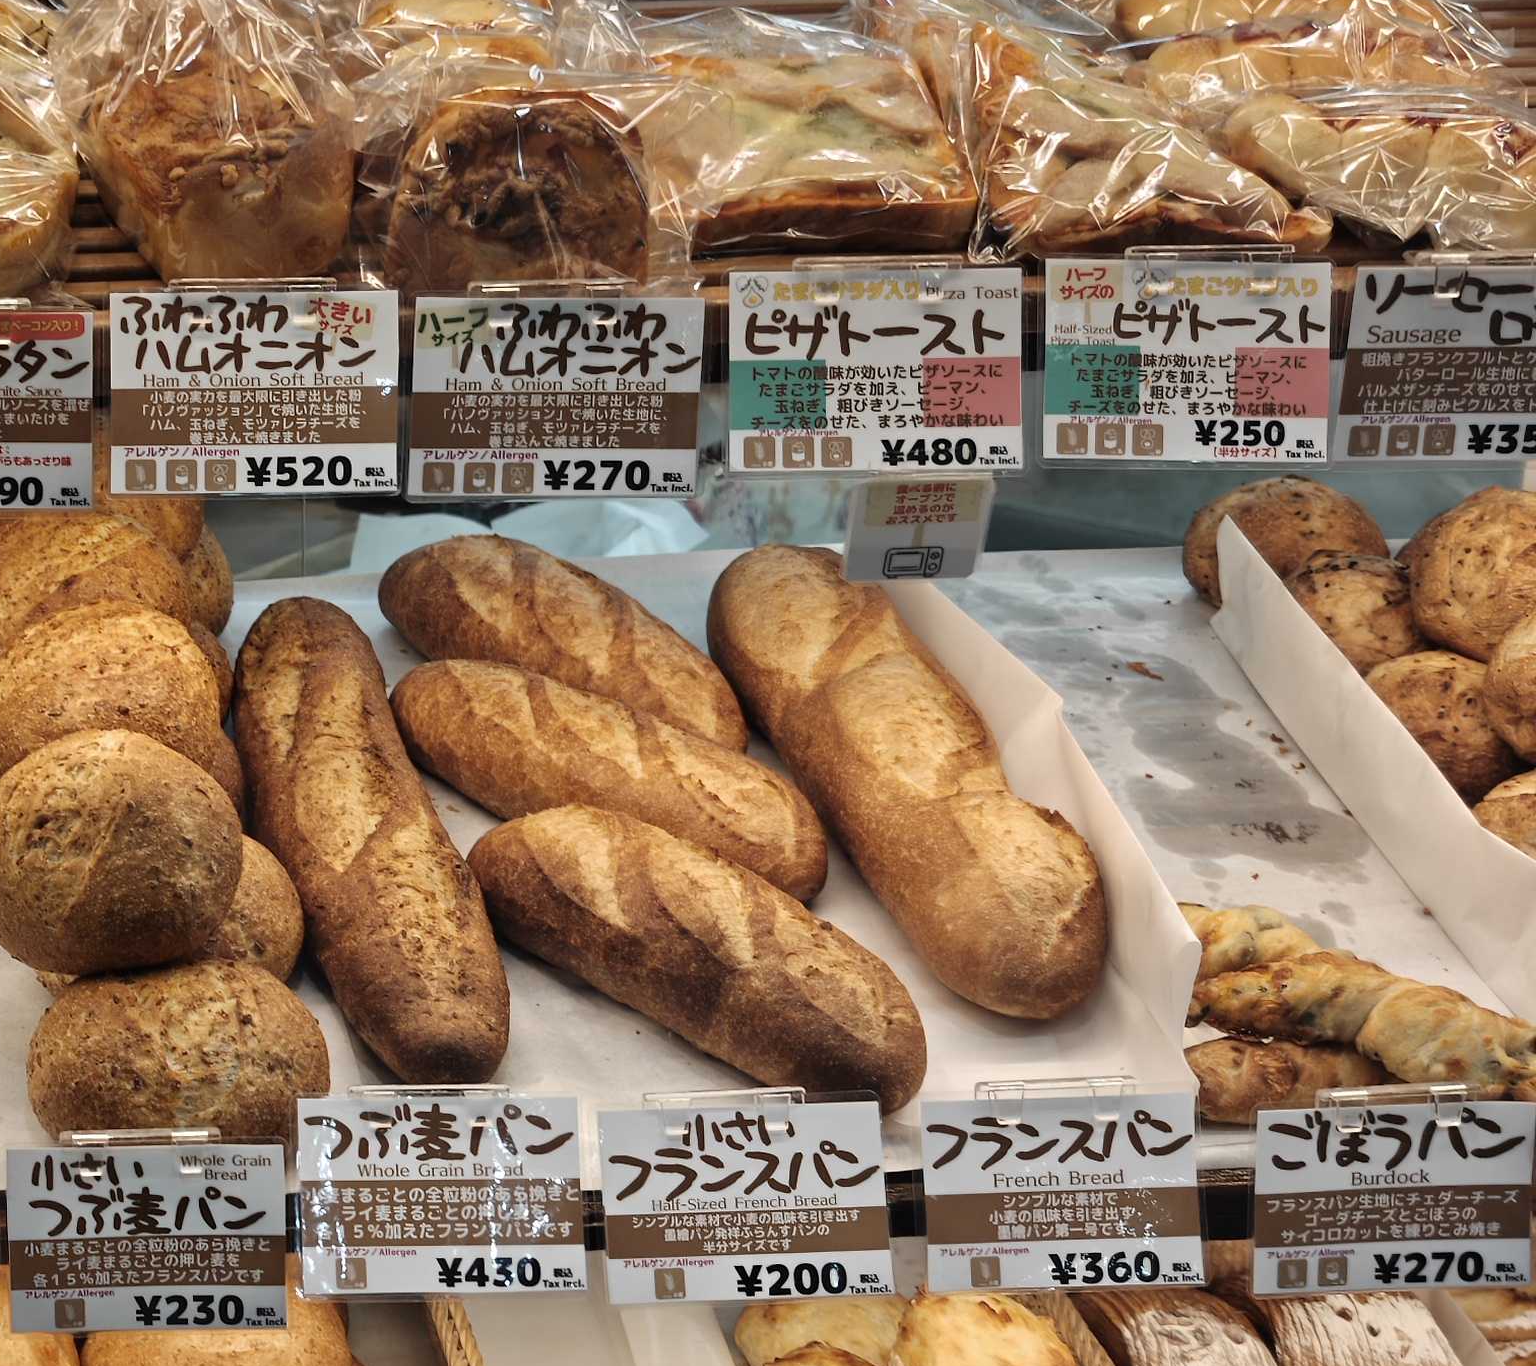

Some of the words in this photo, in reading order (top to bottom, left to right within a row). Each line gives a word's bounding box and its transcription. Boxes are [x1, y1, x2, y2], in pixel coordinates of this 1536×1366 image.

[120, 295, 289, 335] ふわふわ
[309, 297, 372, 325] 大きい
[497, 303, 666, 341] ふわふわ
[1114, 299, 1326, 345] ピザトースト
[746, 305, 1005, 360] ピザトースト
[1366, 325, 1462, 344] Sausage
[135, 331, 376, 373] ハムオニオン
[459, 337, 701, 377] ハムオニオン
[143, 374, 179, 387] Ham
[189, 374, 201, 387] &
[210, 373, 260, 387] Onion
[270, 373, 305, 386] Soft
[314, 372, 364, 386] Bread
[1194, 420, 1286, 447] ¥250
[881, 438, 977, 466] ¥480
[245, 456, 352, 487] ¥520
[543, 460, 650, 491] ¥270
[304, 1103, 574, 1161] つぶ麦パン
[682, 1111, 795, 1151] 小さい
[926, 1109, 1193, 1170] フランスパン
[1269, 1107, 1525, 1171] ごぼうパン
[31, 1153, 144, 1191] 小さい
[181, 1155, 224, 1168] Whole
[232, 1154, 272, 1167] Grain
[204, 1169, 247, 1181] Bread
[608, 1140, 880, 1201] フランスパン
[993, 1173, 1060, 1187] French
[1069, 1170, 1124, 1185] Bread
[1351, 1169, 1430, 1186] Burdock
[29, 1187, 266, 1236] つぶ麦パン
[651, 1197, 727, 1212] Half-Sized
[734, 1196, 787, 1209] French
[794, 1193, 838, 1206] Bread
[1003, 1192, 1119, 1208] シンプルな素材で
[1305, 1207, 1477, 1227] ゴーダチーズとごぼうの
[56, 1253, 240, 1269] ライ麦まるごとの押し麦を
[703, 1239, 792, 1253] 半分サイズです
[734, 1262, 848, 1297] ¥200
[1049, 1250, 1160, 1285] ¥360
[1373, 1251, 1485, 1283] ¥270
[134, 1295, 244, 1325] ¥230
